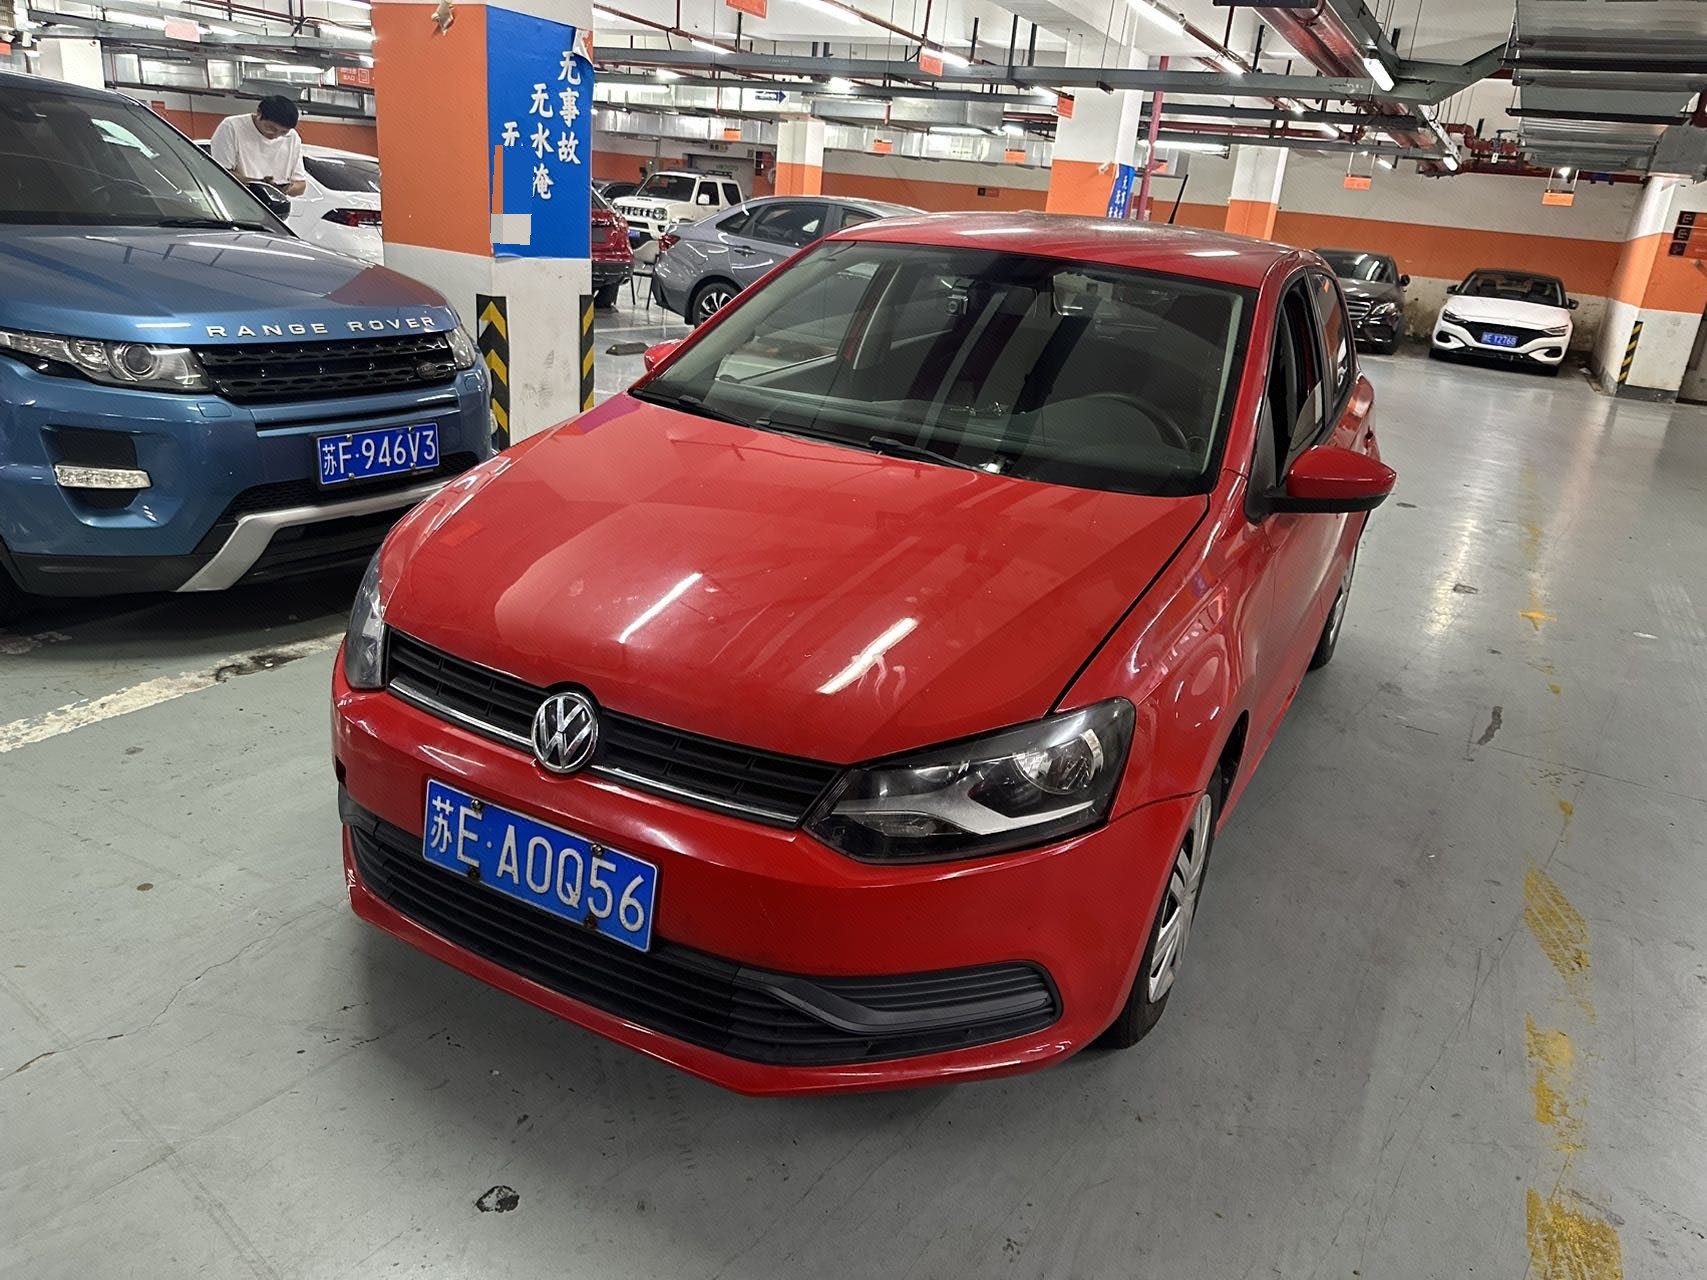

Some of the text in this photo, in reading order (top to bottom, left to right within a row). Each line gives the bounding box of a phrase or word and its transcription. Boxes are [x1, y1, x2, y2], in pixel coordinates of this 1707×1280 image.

[528, 83, 554, 200] 无水淹
[557, 50, 581, 165] 无事故
[206, 316, 436, 338] RANGE ROVER
